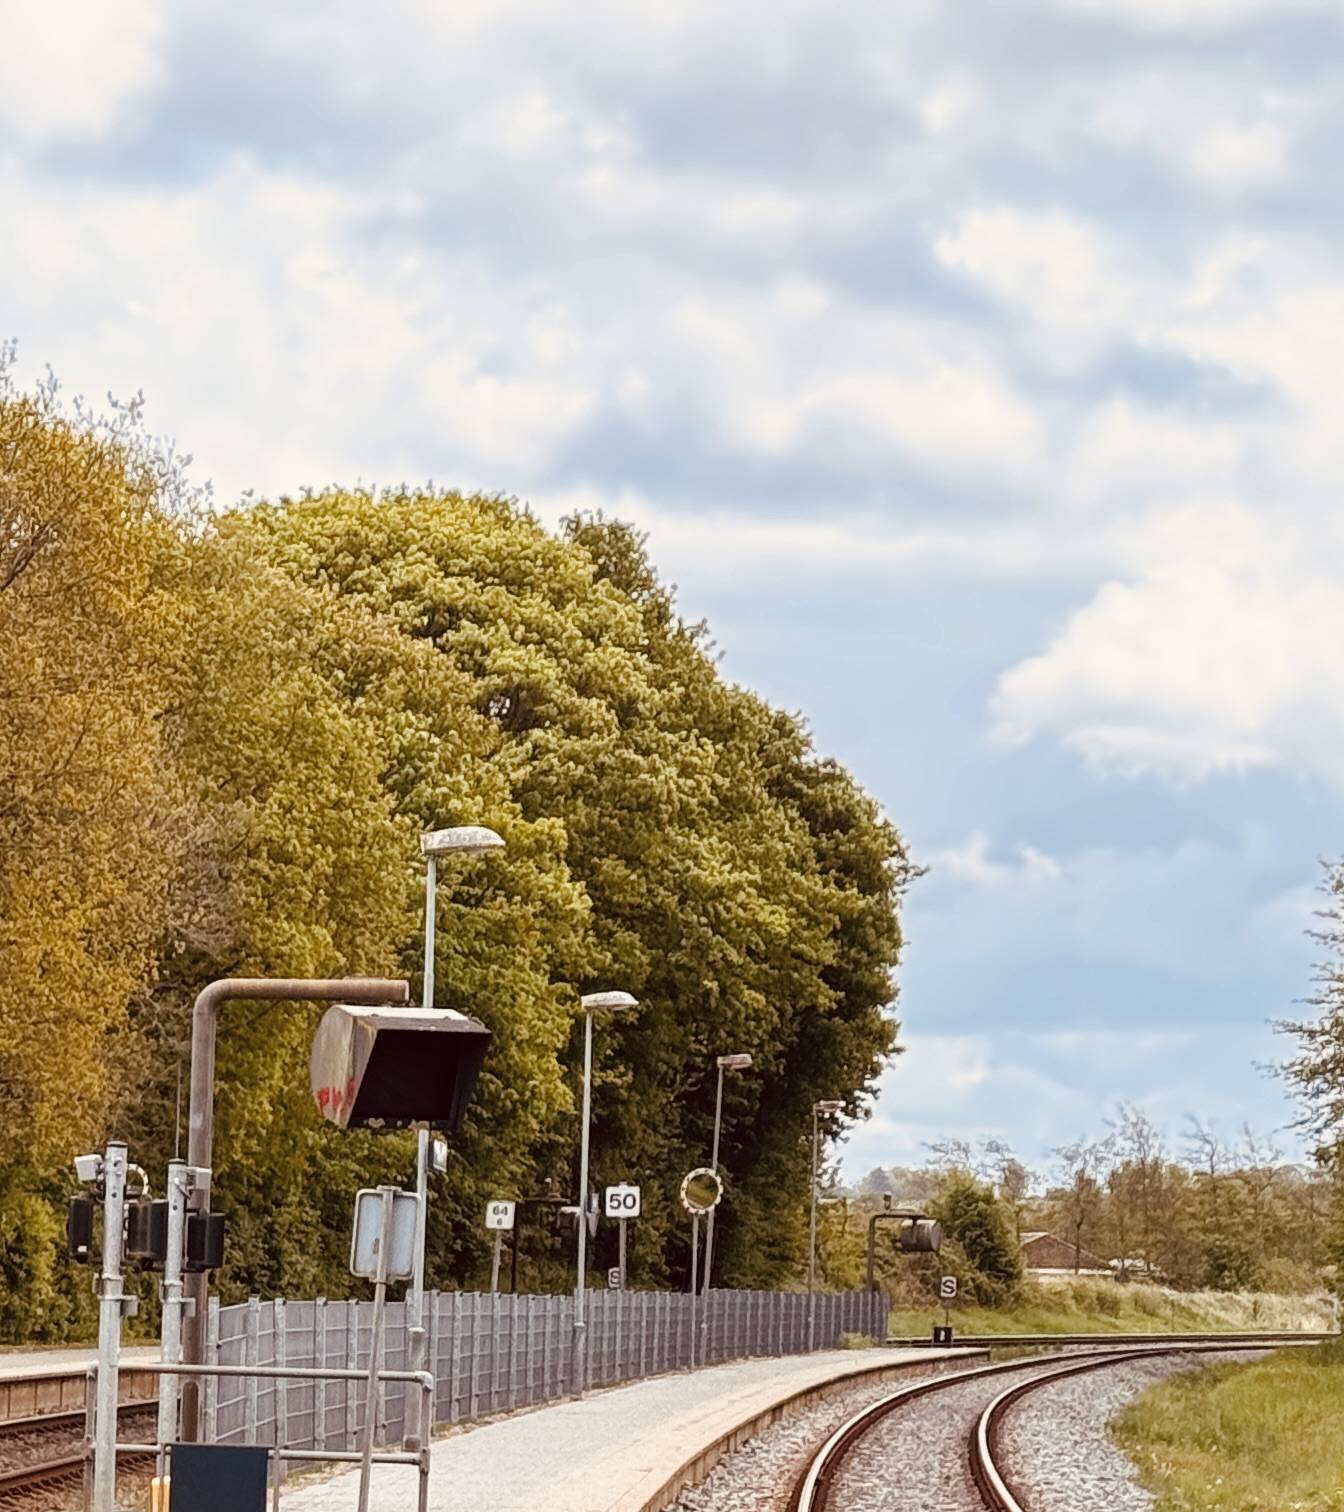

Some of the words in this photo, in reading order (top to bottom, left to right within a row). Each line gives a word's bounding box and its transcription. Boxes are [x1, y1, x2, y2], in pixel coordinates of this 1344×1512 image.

[609, 1193, 637, 1210] 50
[492, 1205, 508, 1216] 64
[942, 1279, 955, 1295] S
